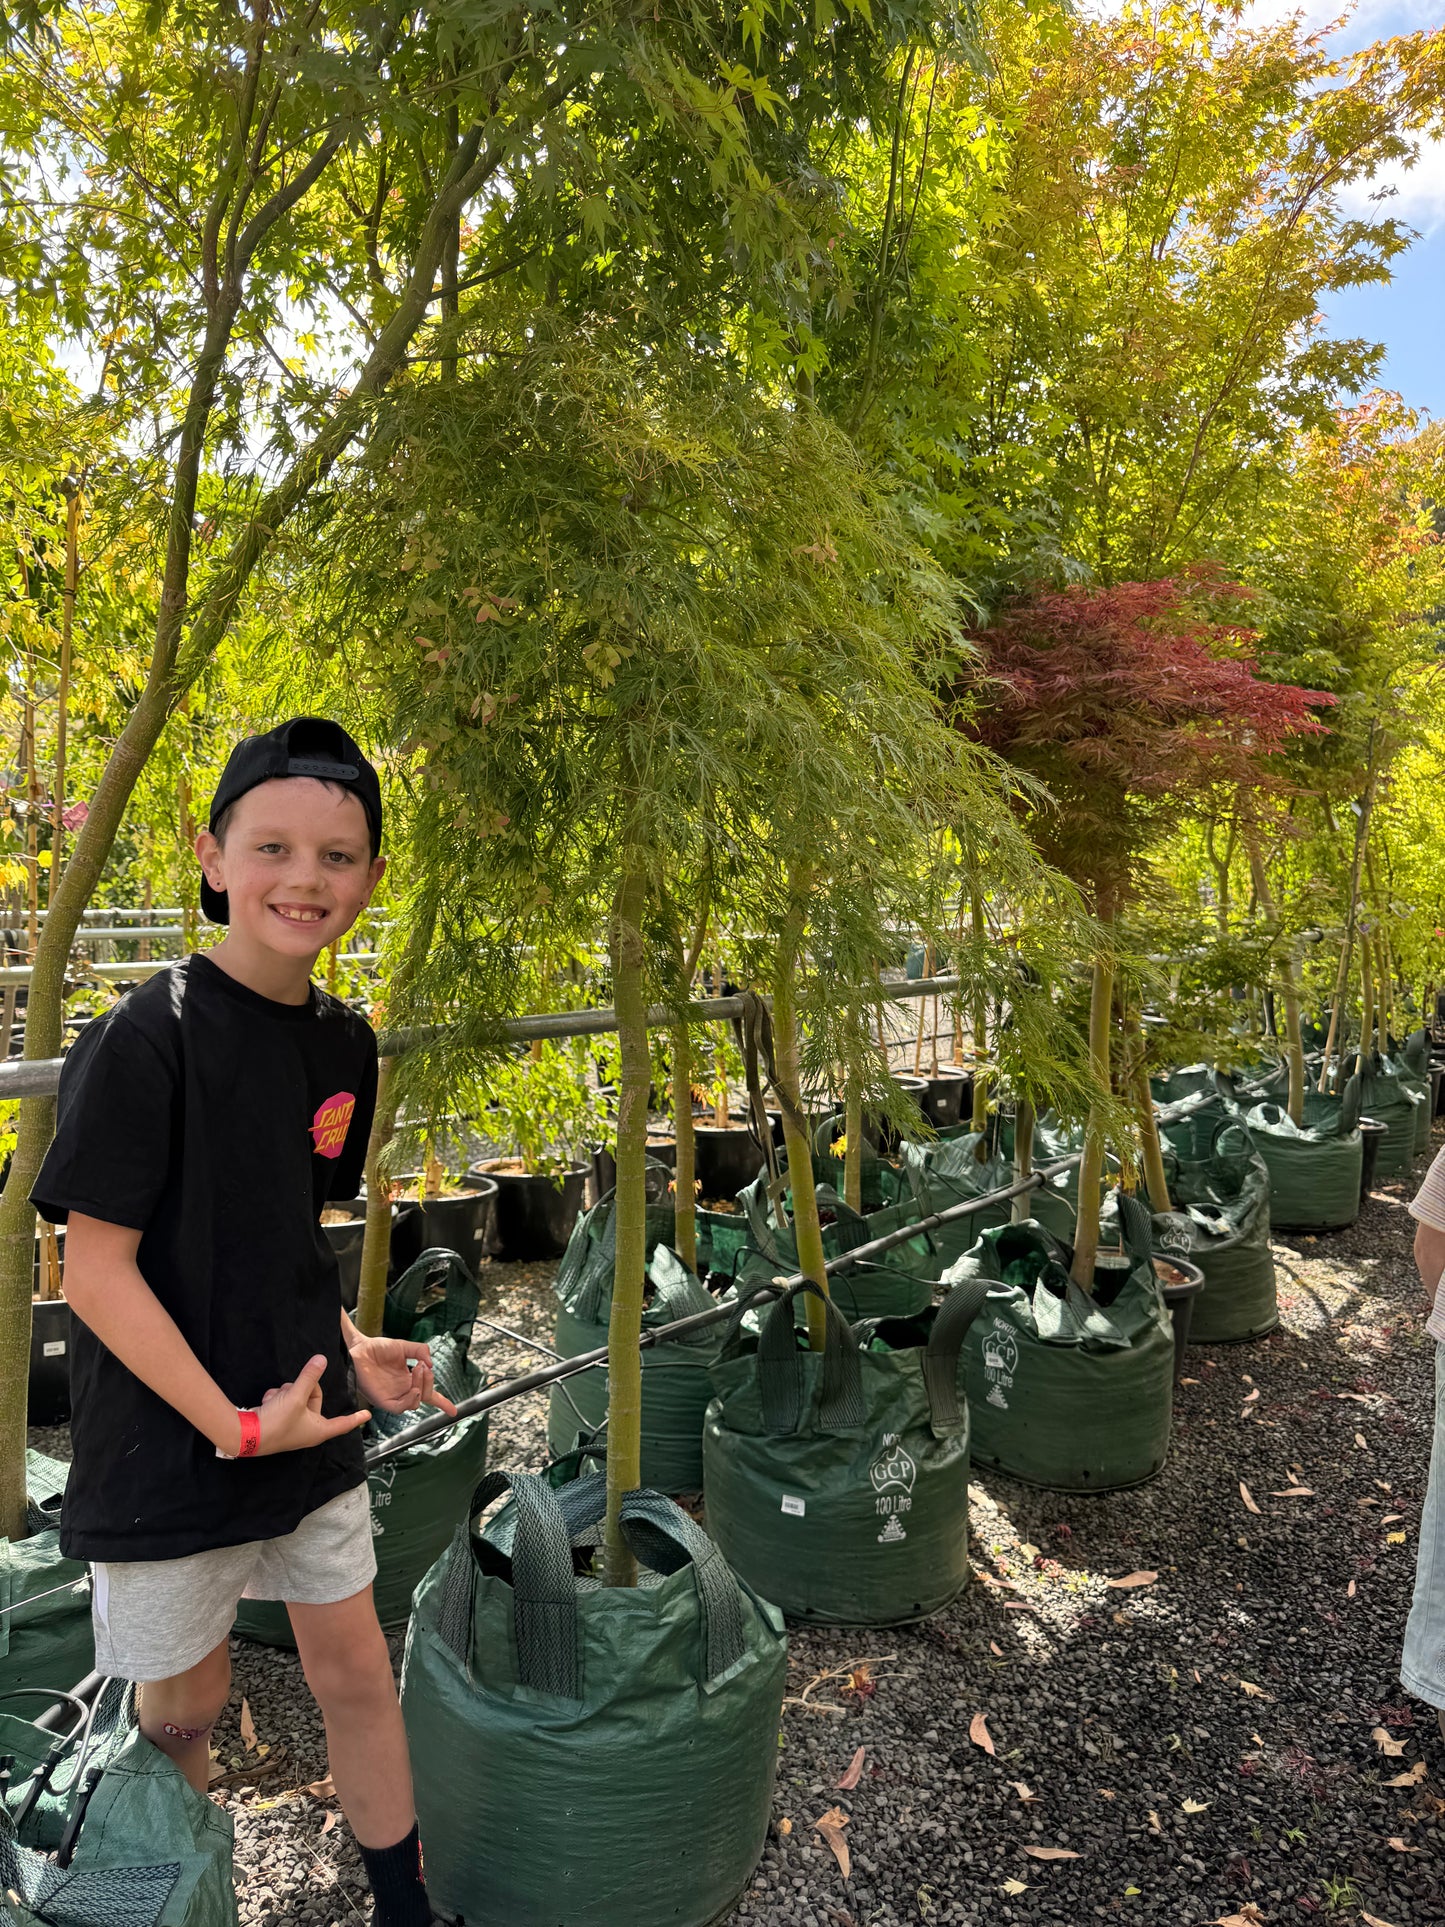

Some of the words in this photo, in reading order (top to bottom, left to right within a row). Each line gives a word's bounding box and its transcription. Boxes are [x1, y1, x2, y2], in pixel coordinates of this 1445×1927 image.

[313, 1124, 348, 1153] CRU
[993, 1316, 1018, 1336] NORTH
[985, 1340, 1015, 1361] GCP
[996, 1367, 1014, 1388] Litre
[874, 1460, 911, 1480] GCP
[875, 1496, 892, 1515] 100
[893, 1494, 912, 1513] Litre
